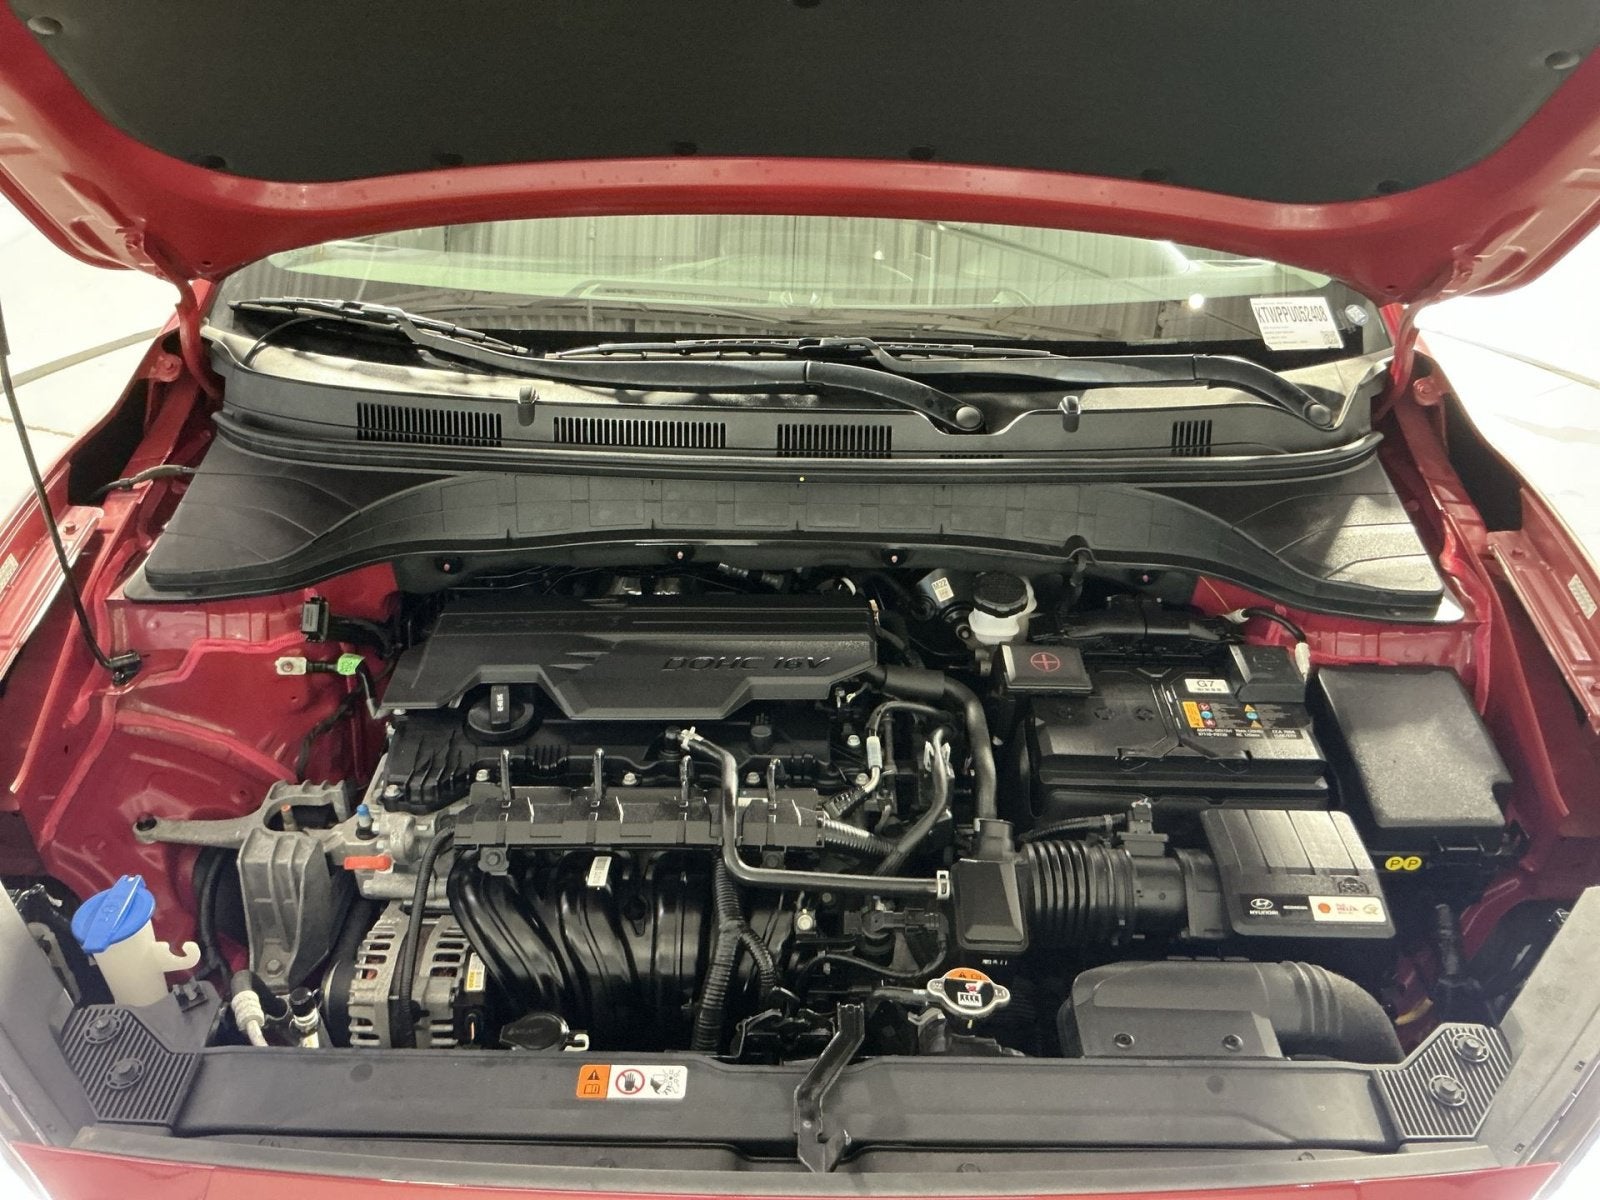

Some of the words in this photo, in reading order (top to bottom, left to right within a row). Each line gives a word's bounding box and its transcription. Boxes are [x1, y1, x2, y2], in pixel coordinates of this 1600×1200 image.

[1254, 305, 1328, 324] KTWPPU052408
[661, 656, 765, 672] DOHC
[773, 656, 832, 671] 16V
[1197, 680, 1215, 688] G7
